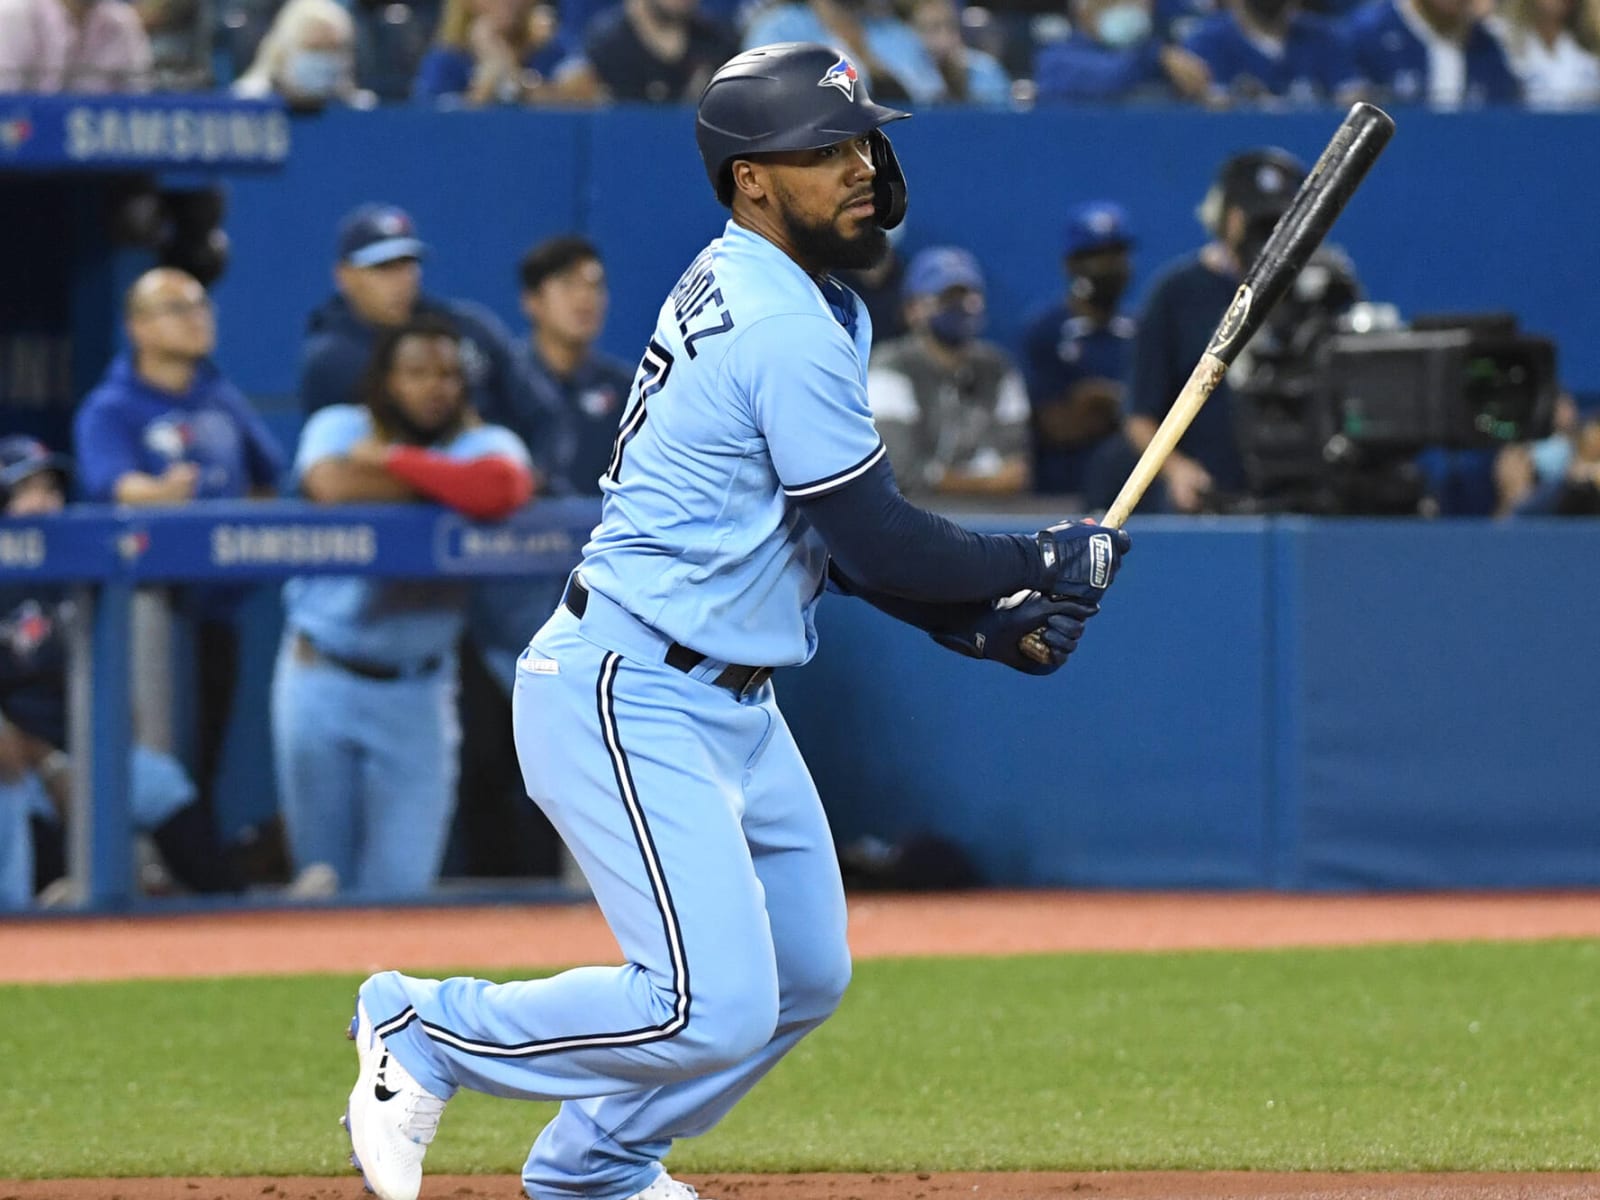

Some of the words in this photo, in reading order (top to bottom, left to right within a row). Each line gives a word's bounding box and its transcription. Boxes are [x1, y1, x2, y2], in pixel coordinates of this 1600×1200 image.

[65, 106, 289, 161] SAMSUNG
[211, 524, 377, 567] SAMSUNG
[1092, 537, 1109, 585] Franklin
